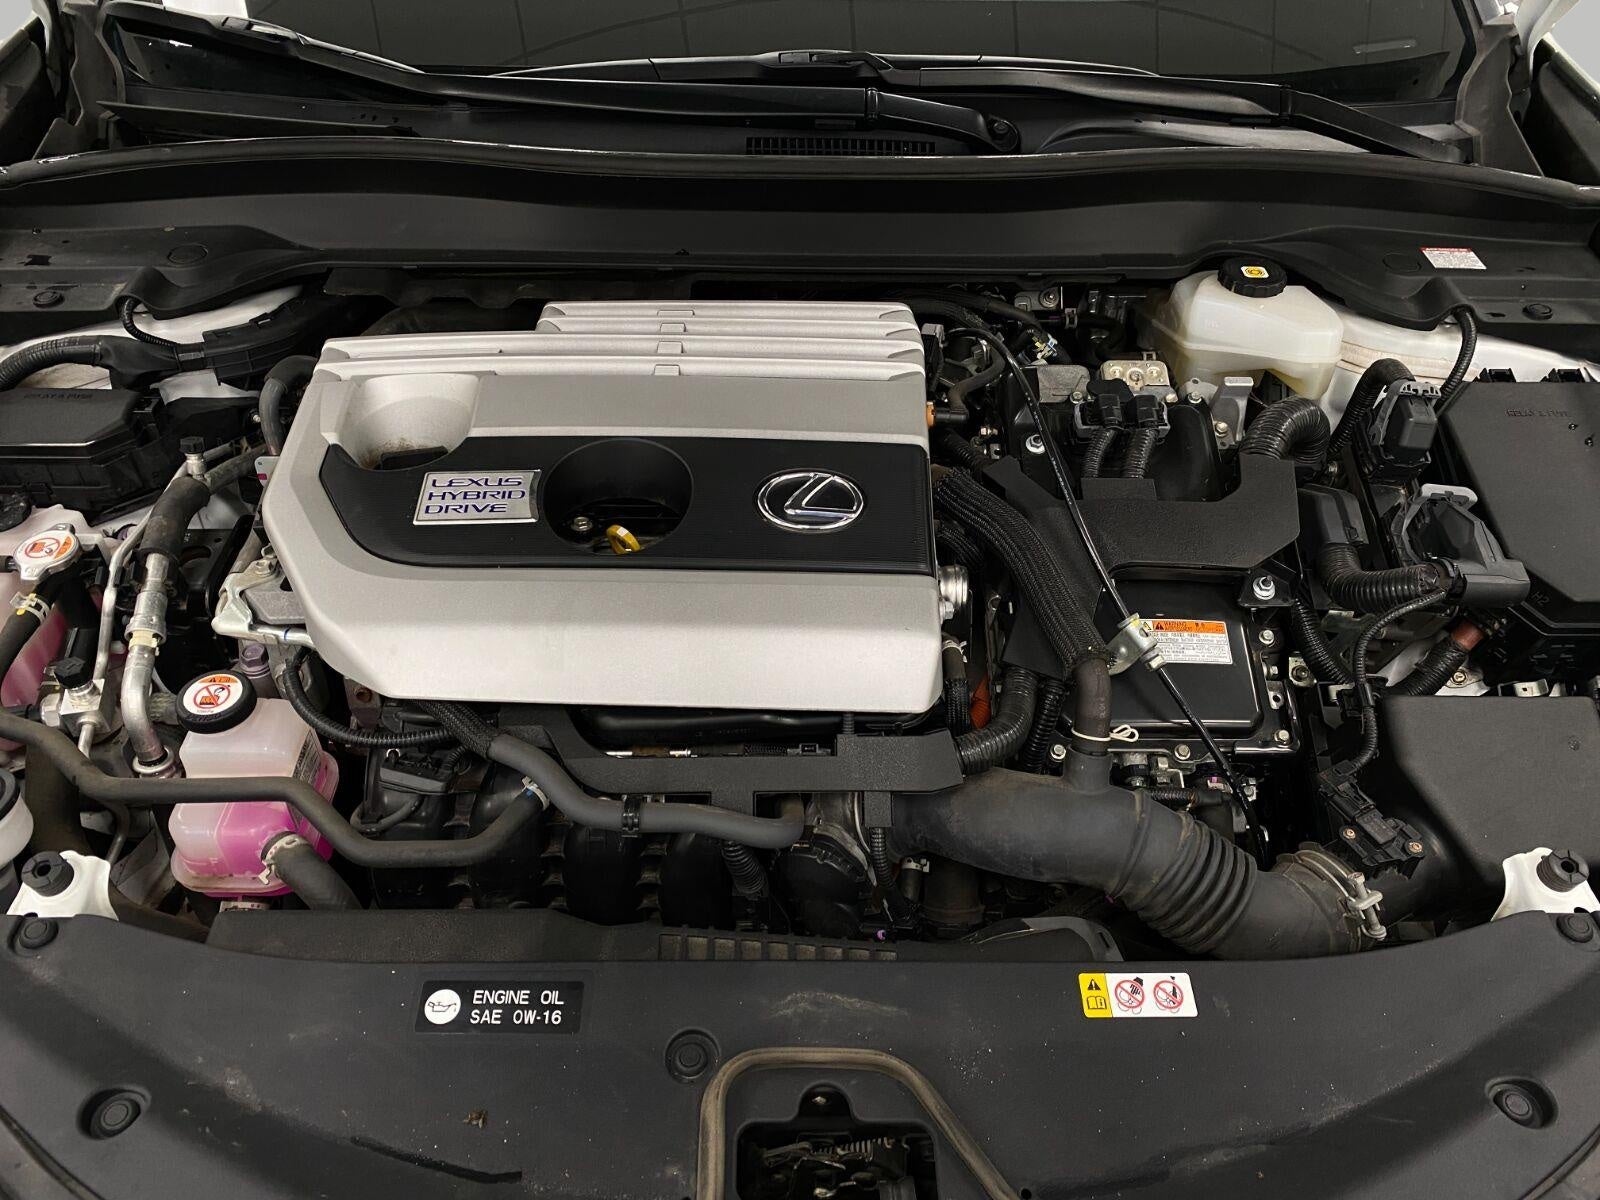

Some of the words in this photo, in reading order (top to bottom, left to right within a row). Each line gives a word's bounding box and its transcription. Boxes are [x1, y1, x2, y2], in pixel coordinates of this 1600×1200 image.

[431, 477, 522, 488] LEXUS
[428, 490, 526, 501] HYBRID
[424, 503, 508, 514] DRIVE
[472, 990, 530, 1005] ENGINE
[540, 990, 565, 1005] OIL
[469, 1009, 502, 1025] SAE
[512, 1009, 562, 1025] 0W-16
